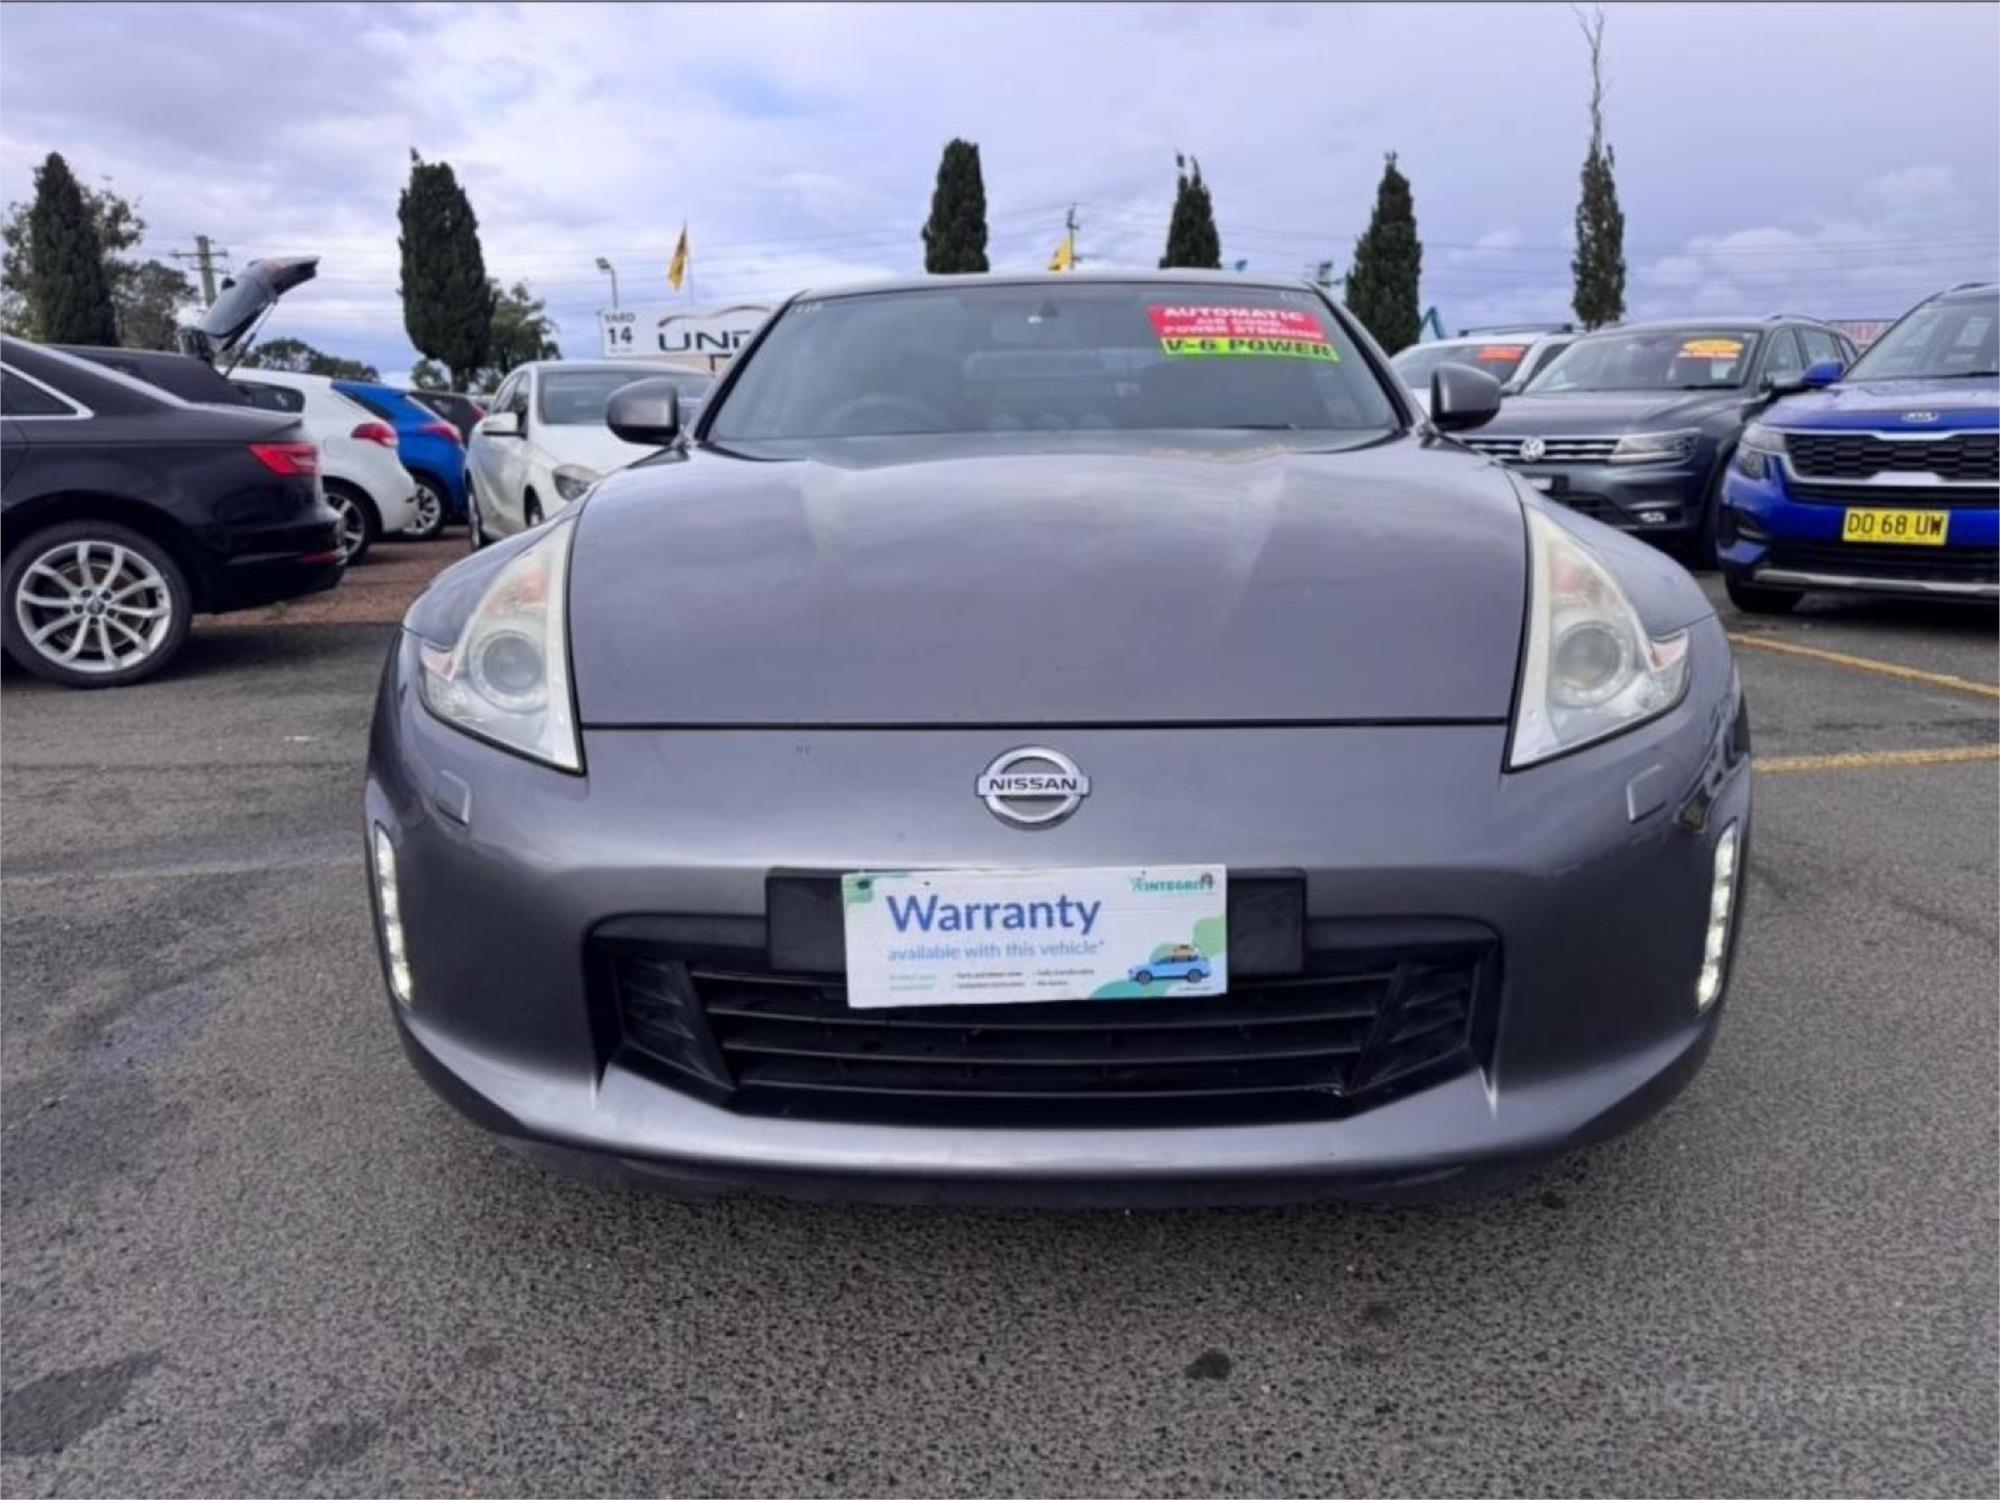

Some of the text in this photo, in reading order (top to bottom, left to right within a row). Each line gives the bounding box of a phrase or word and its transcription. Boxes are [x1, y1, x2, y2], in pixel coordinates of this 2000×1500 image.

[1164, 306, 1304, 321] AUTOMATIC
[608, 327, 632, 345] 14
[1167, 340, 1330, 356] V-6 POWER
[1881, 514, 1908, 536] 68
[1914, 514, 1945, 537] UW
[988, 777, 1077, 791] NISSAN
[886, 894, 1101, 936] Warranty
[888, 943, 960, 962] available
[964, 942, 1002, 959] with
[1006, 940, 1036, 958] this
